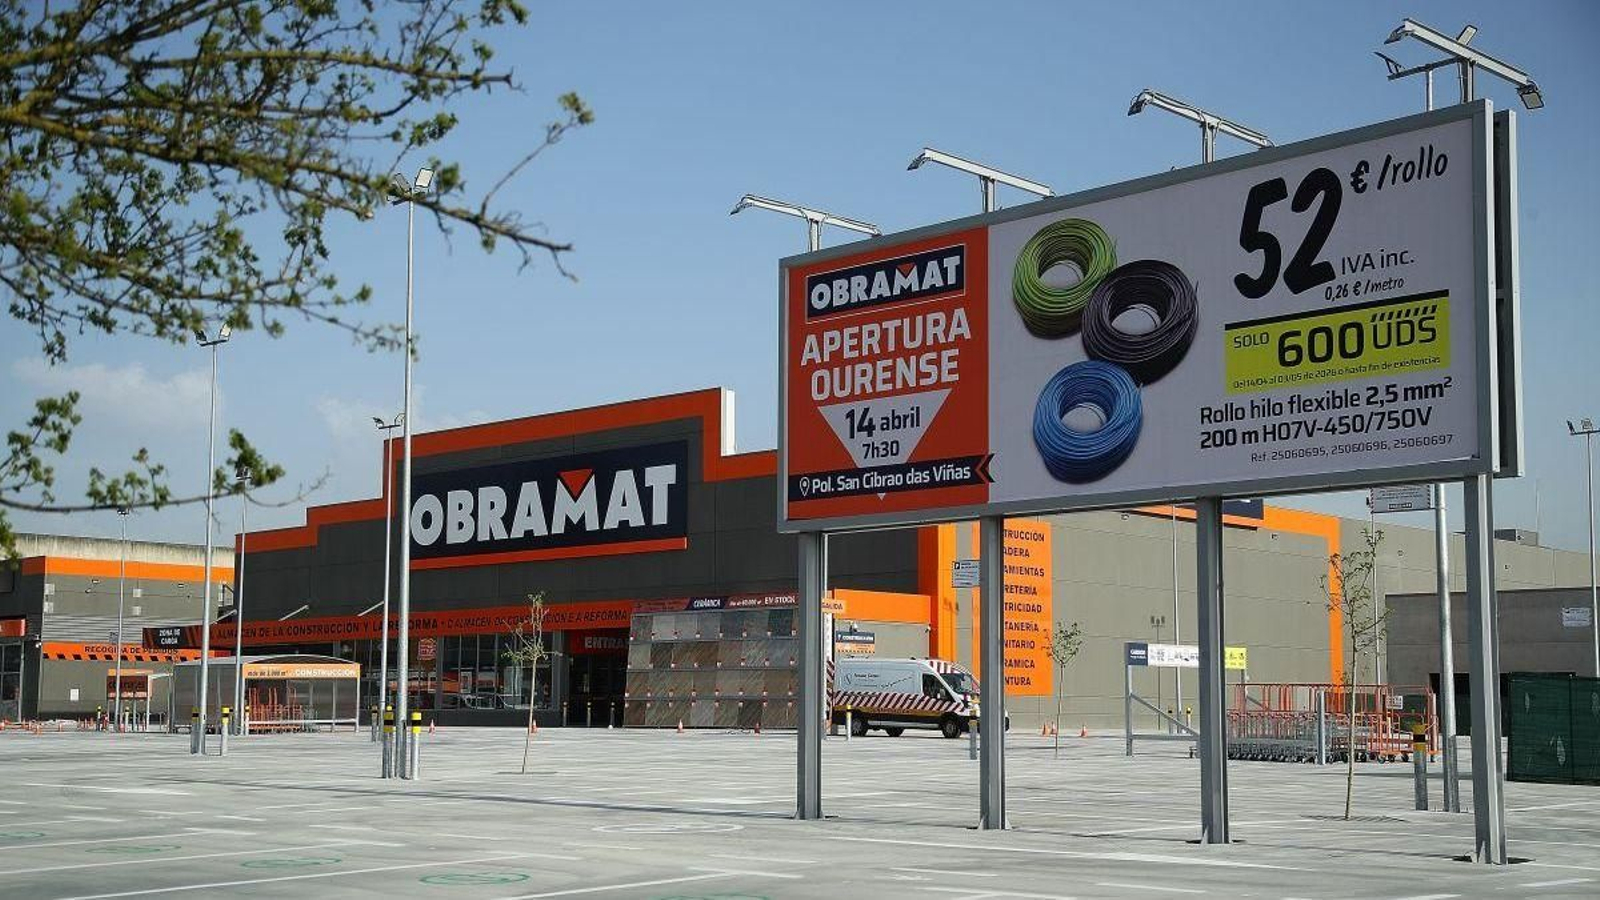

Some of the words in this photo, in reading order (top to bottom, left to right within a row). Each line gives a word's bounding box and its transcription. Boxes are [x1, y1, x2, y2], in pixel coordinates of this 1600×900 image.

[1233, 167, 1343, 299] 52
[1341, 252, 1376, 275] IVA
[1380, 248, 1414, 269] inc.
[810, 255, 961, 310] OBRAMAT
[1324, 283, 1349, 301] 0,26
[800, 308, 971, 366] APERTURA
[1233, 331, 1270, 349] SOLO
[1277, 321, 1364, 368] 600
[1371, 316, 1437, 350] UDS
[811, 348, 960, 401] OURENSE
[1200, 402, 1245, 425] Rollo
[1250, 398, 1284, 419] hilo
[1288, 388, 1361, 414] flexible
[1365, 384, 1399, 409] 2,5
[1403, 376, 1453, 401] mm²
[844, 407, 876, 439] 14
[880, 406, 921, 432] abril
[1200, 427, 1237, 450] 200
[1241, 430, 1259, 445] m
[1263, 406, 1433, 443] H07V-450/750V
[862, 440, 900, 460] 7h30
[1251, 450, 1270, 463] Ref.
[812, 476, 835, 494] Pol.
[837, 474, 860, 491] San
[863, 471, 904, 489] Cibrao
[906, 468, 930, 485] das
[932, 463, 972, 482] Viñas
[410, 463, 677, 546] OBRAMAT
[1004, 546, 1030, 558] ADERA
[1004, 564, 1045, 577] AMIENTAS
[1004, 602, 1042, 613] TRICIDAD
[387, 618, 438, 631] REORMA
[1004, 639, 1036, 650] NITARIO
[1004, 676, 1031, 686] NTURA
